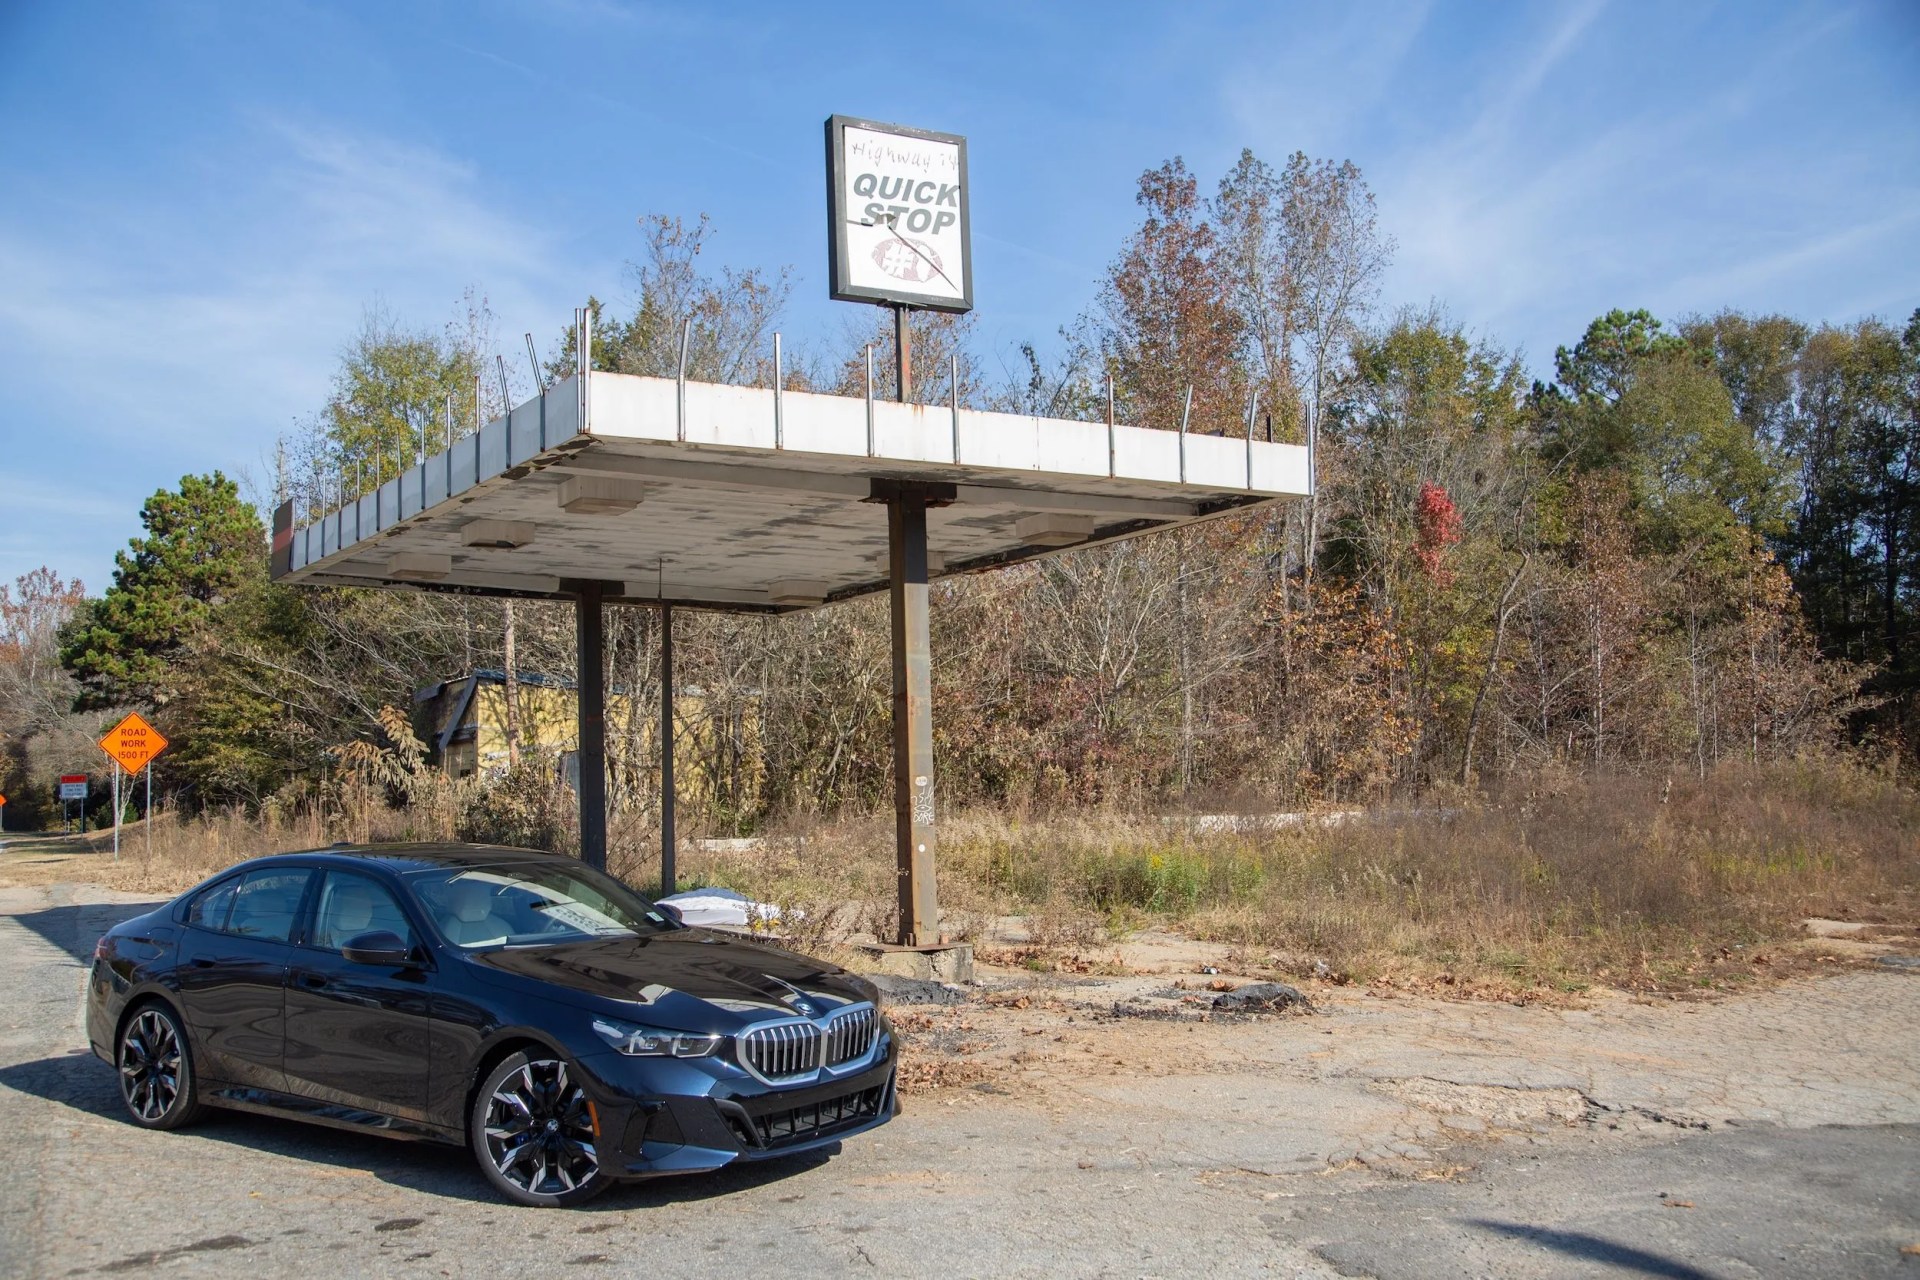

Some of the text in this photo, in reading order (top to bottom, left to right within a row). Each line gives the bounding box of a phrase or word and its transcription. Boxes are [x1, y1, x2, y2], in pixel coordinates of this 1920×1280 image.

[852, 140, 930, 173] Highway
[854, 173, 960, 207] QUICK
[861, 203, 956, 235] STOP
[121, 728, 147, 736] ROAD
